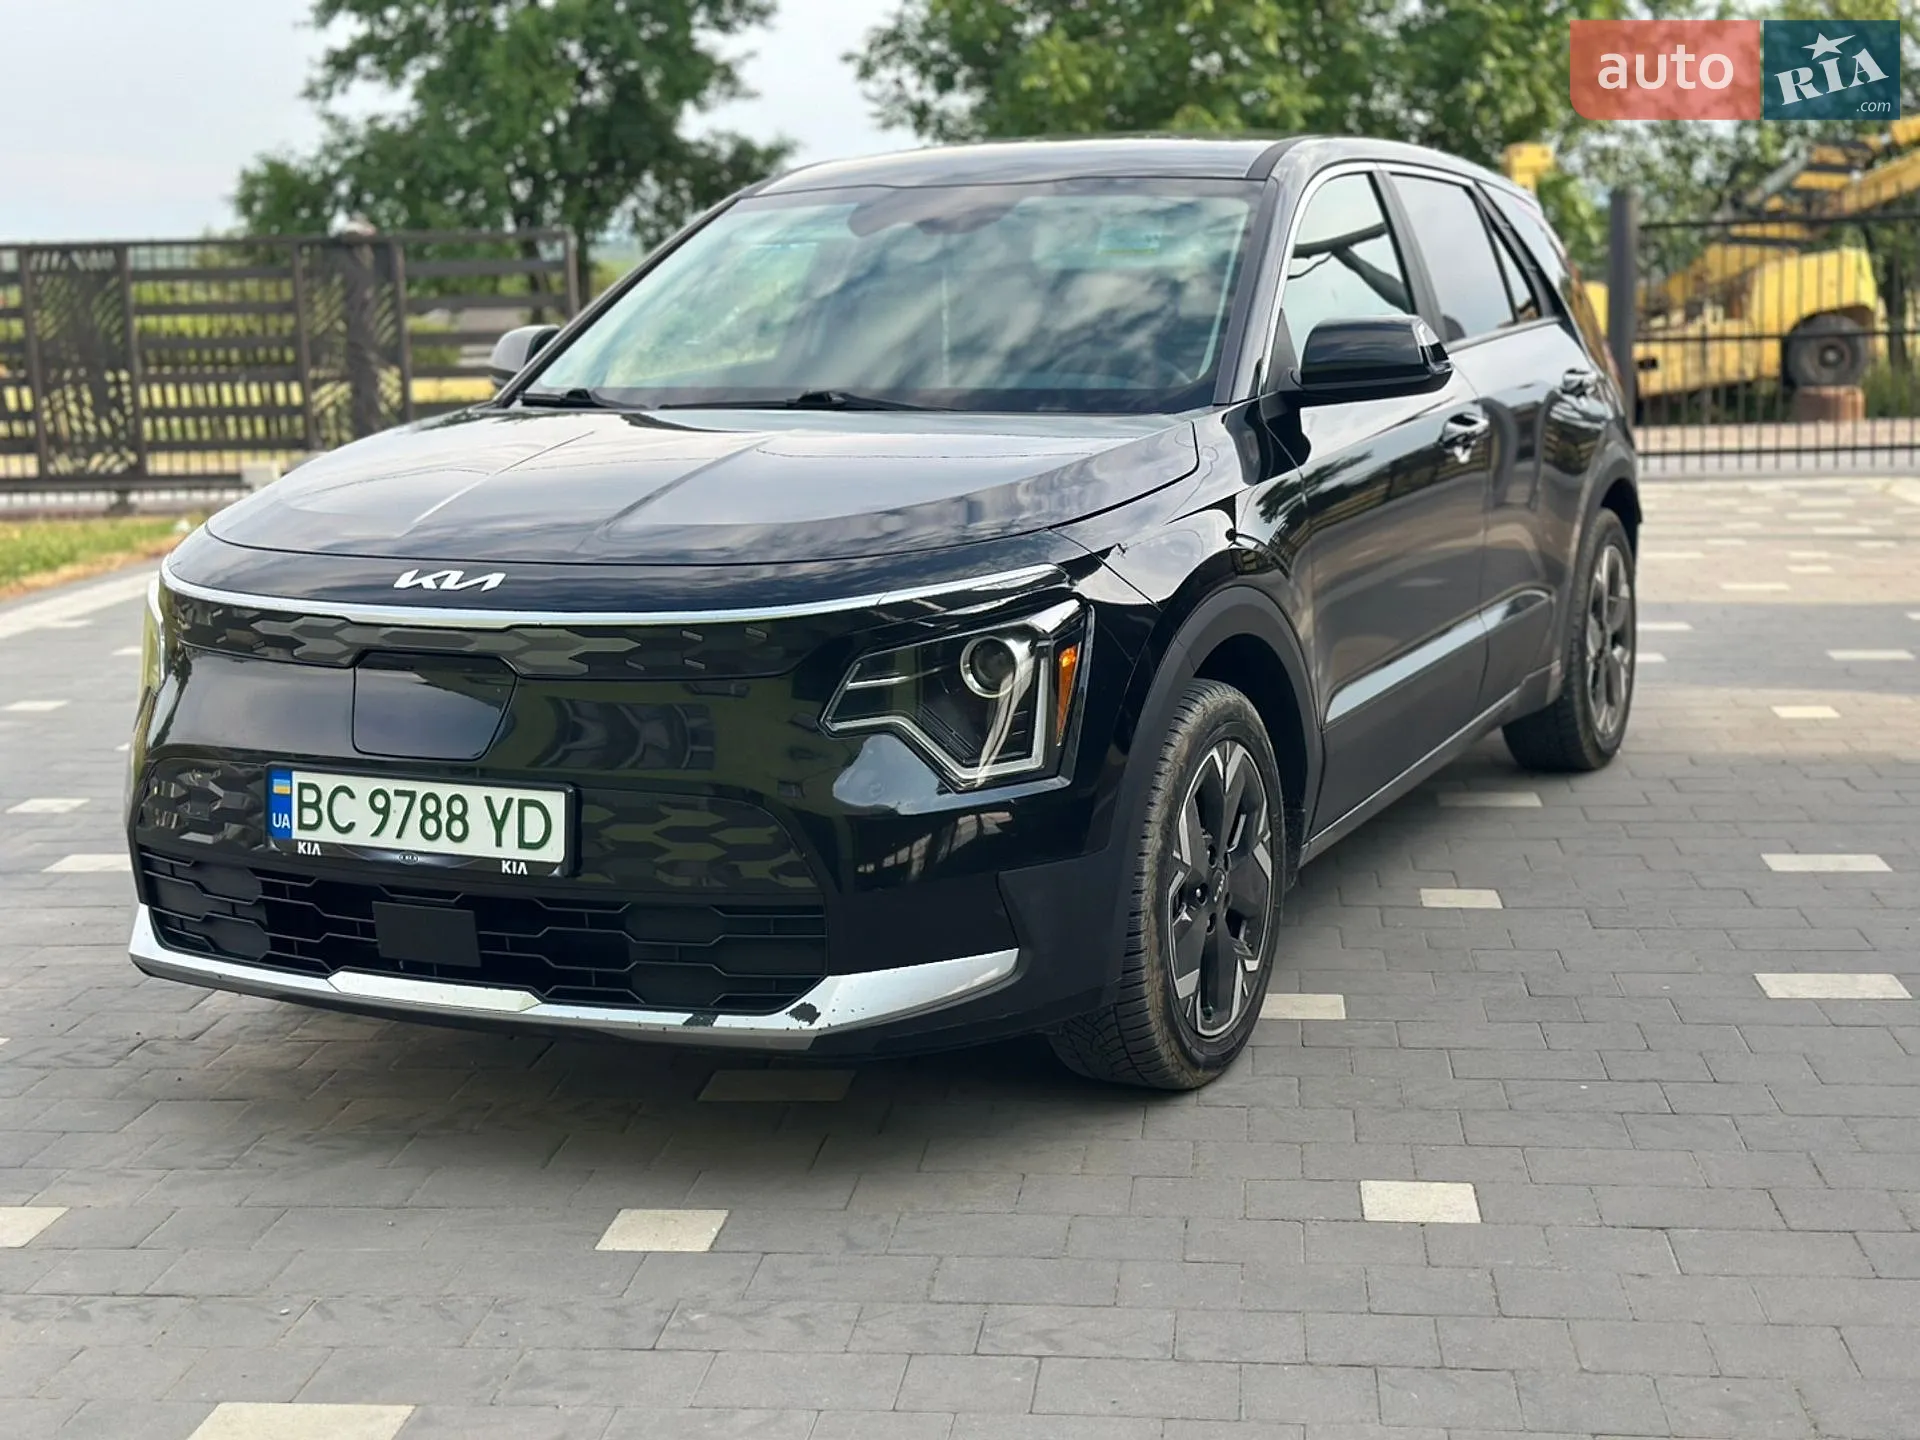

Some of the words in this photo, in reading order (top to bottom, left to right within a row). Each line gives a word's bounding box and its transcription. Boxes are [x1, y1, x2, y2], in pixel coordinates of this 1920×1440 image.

[272, 812, 291, 829] UA
[297, 782, 356, 834] BC
[368, 788, 469, 843] 9788
[484, 796, 552, 850] YD
[297, 841, 321, 856] KIA
[501, 860, 528, 875] KIA
